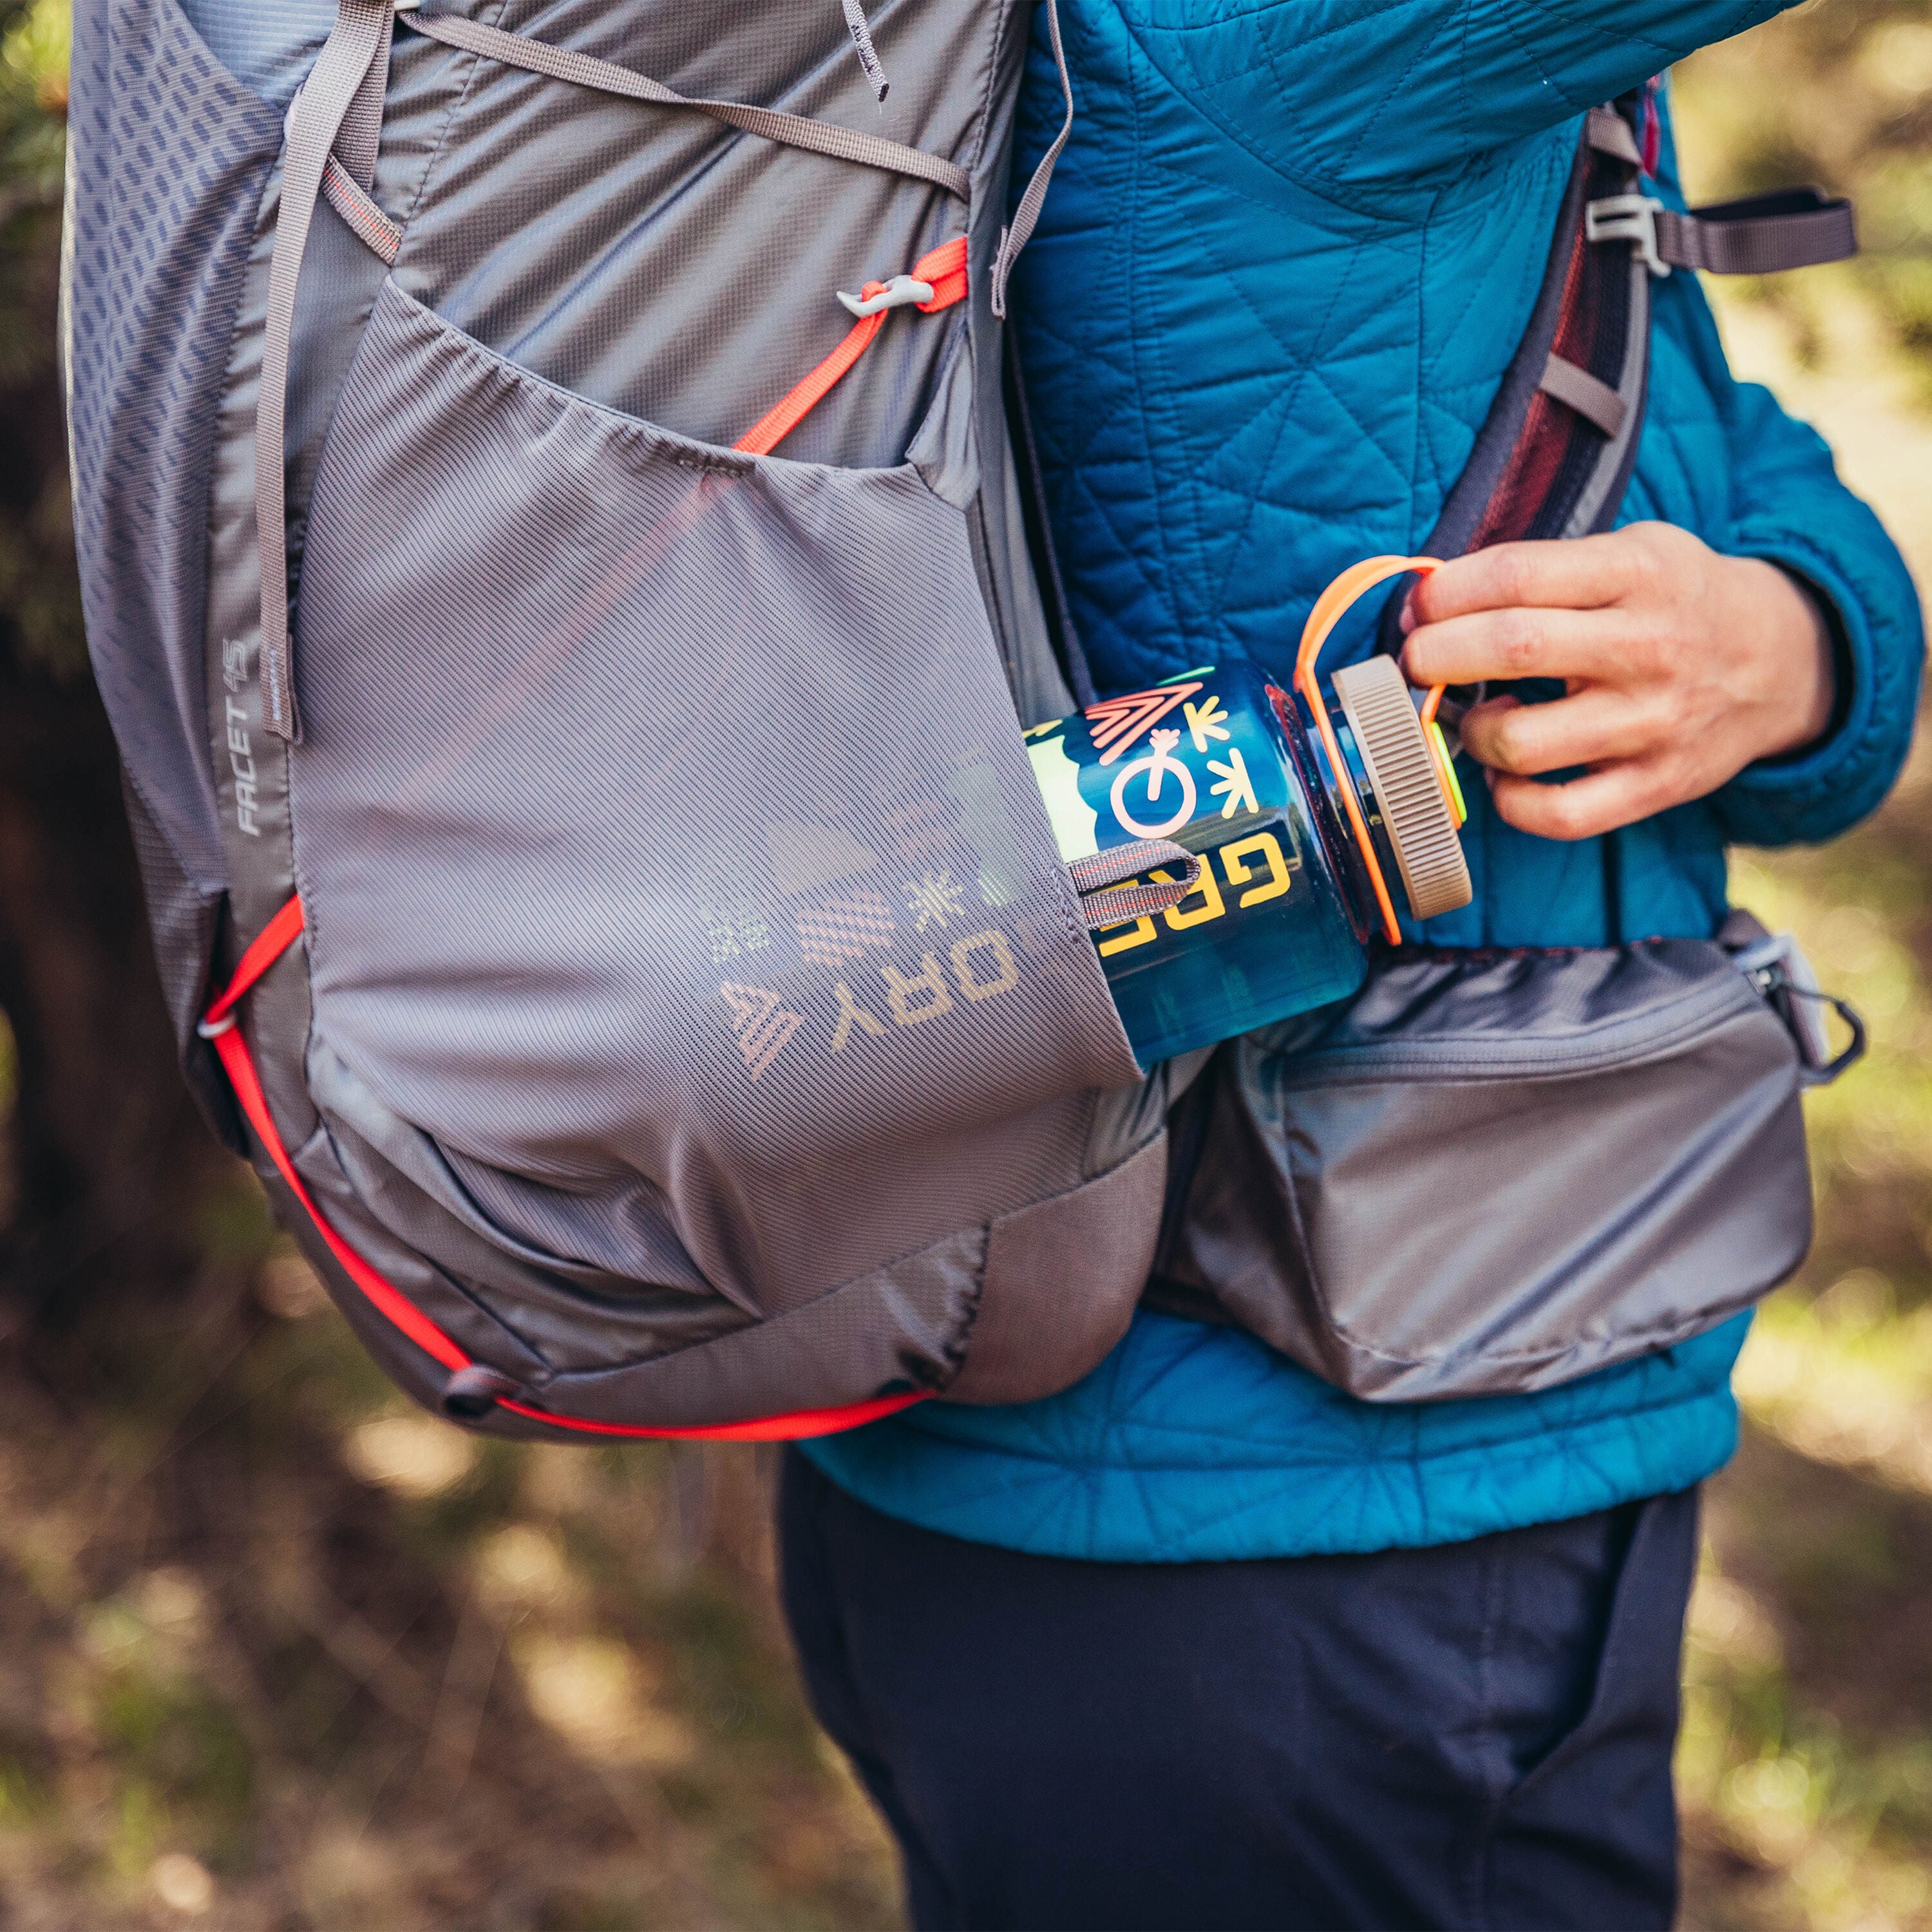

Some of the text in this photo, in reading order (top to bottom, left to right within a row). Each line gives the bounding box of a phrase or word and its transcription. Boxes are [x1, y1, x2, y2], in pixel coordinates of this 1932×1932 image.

[223, 638, 260, 836] FACET 45
[831, 832, 1291, 1053] GREORY
